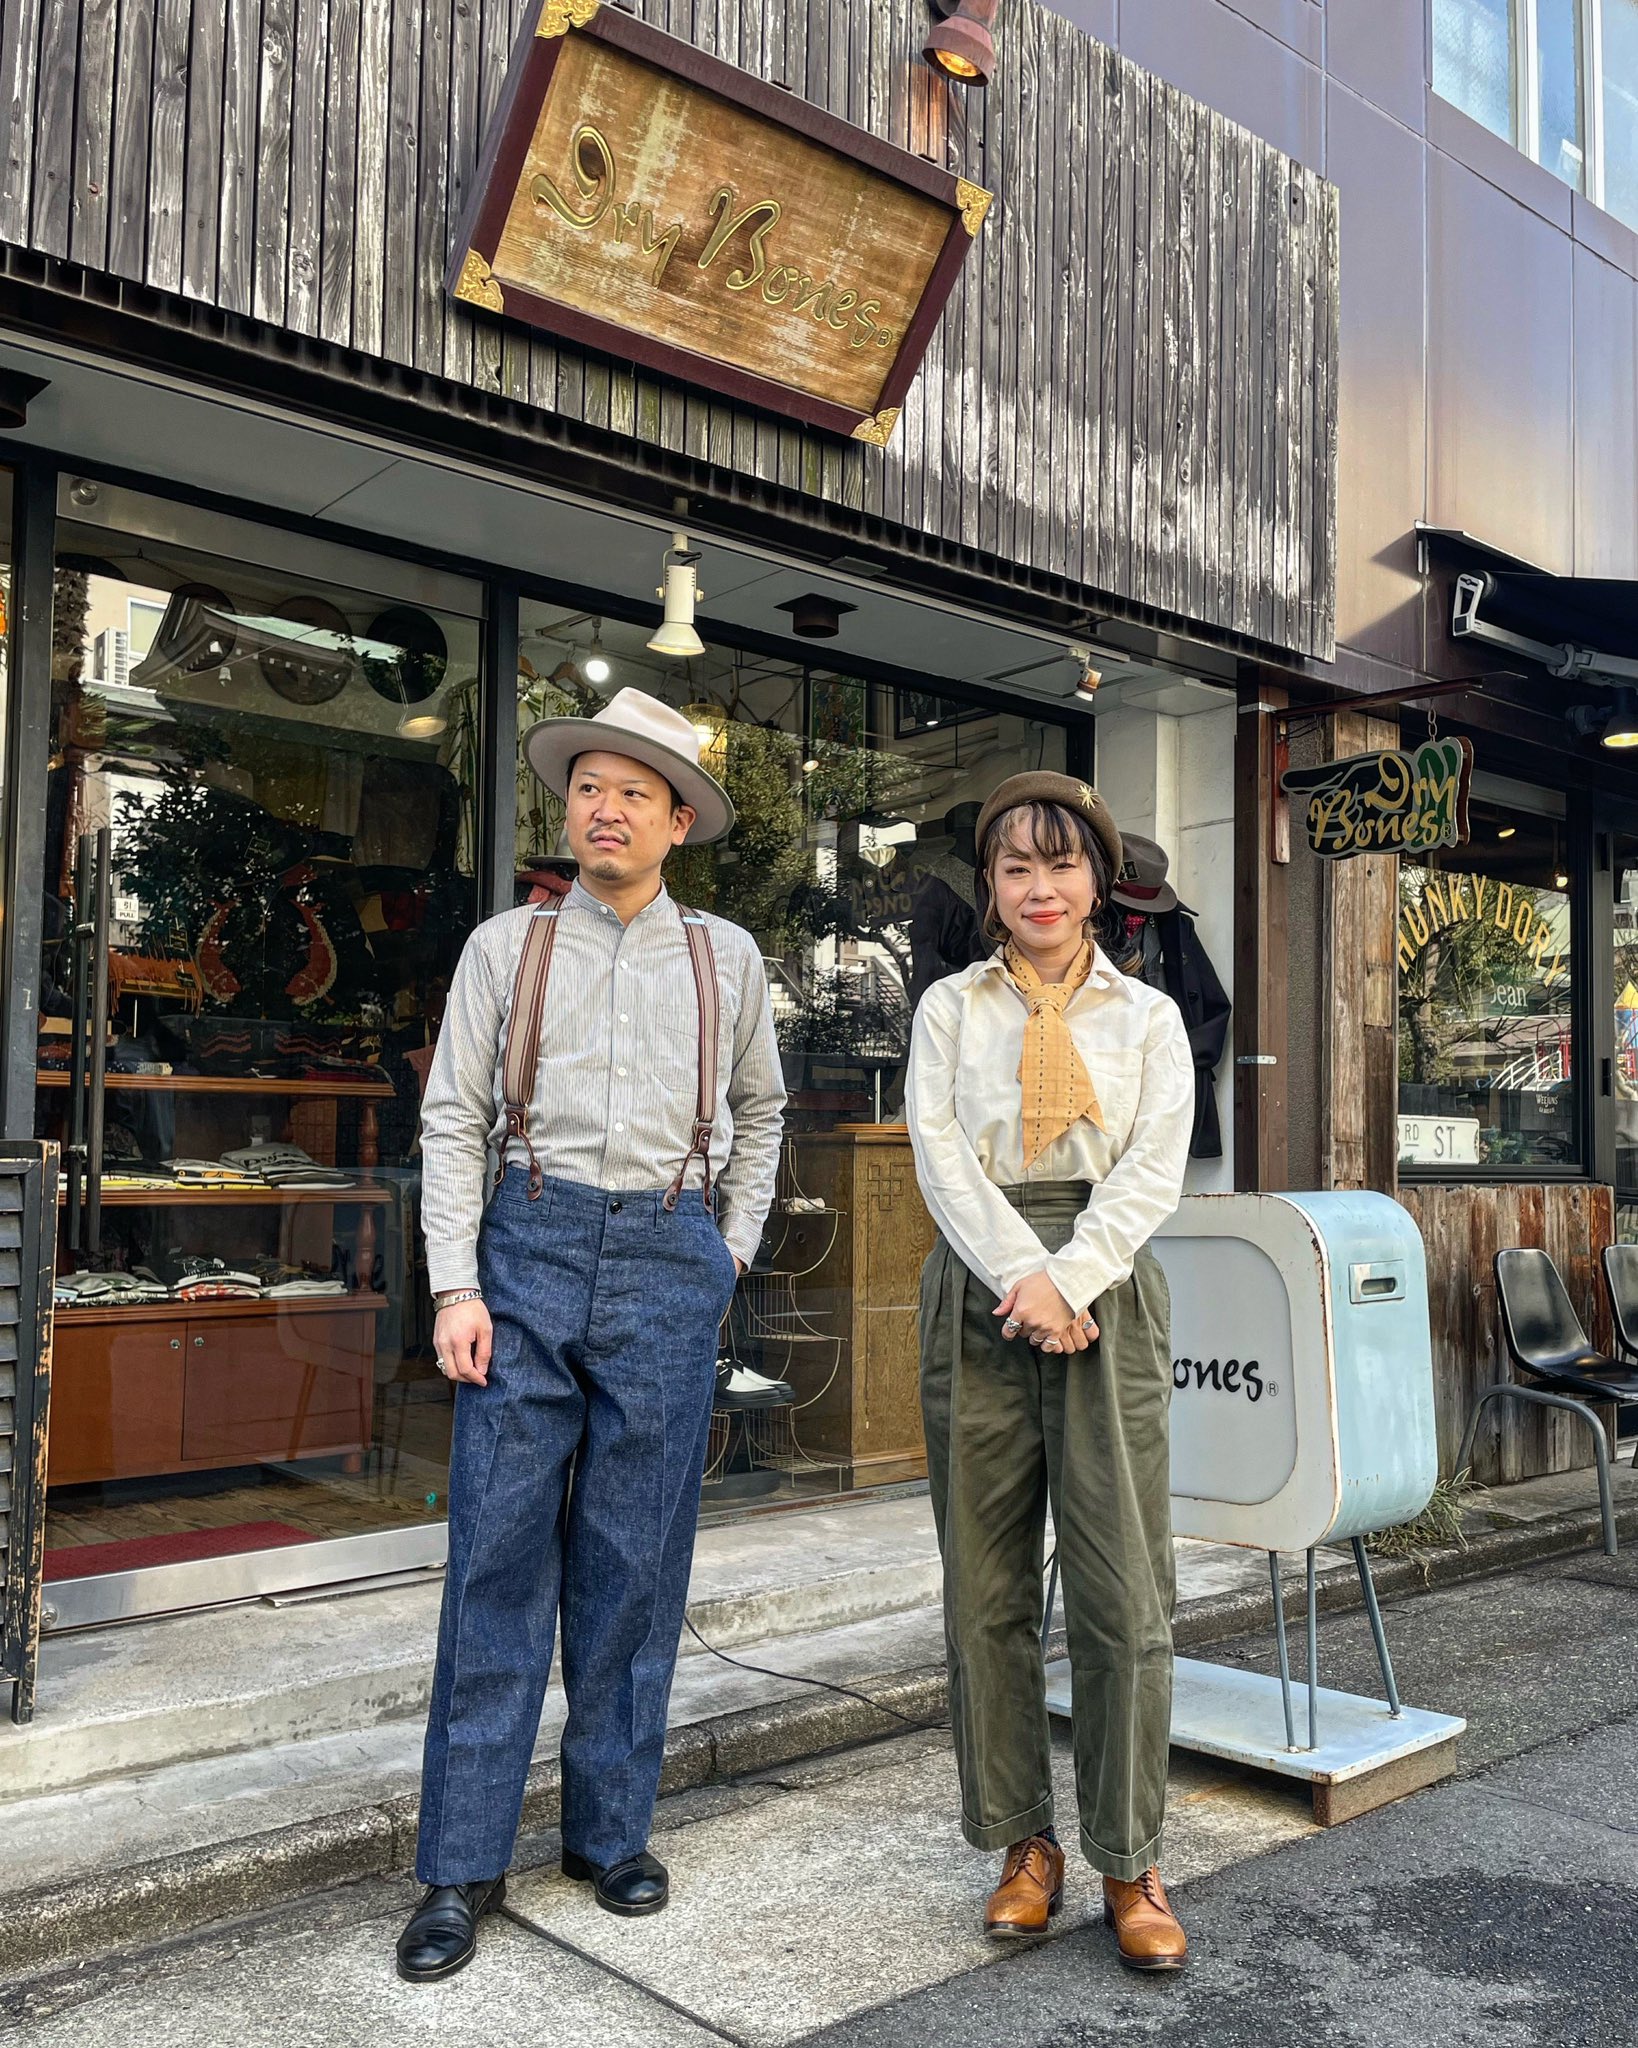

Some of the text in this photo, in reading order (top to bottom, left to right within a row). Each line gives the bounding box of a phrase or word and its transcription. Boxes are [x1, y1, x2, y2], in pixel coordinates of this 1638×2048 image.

[530, 125, 683, 289] Dry
[1364, 752, 1456, 821] Dry
[1398, 873, 1566, 988] HUNKY DORY
